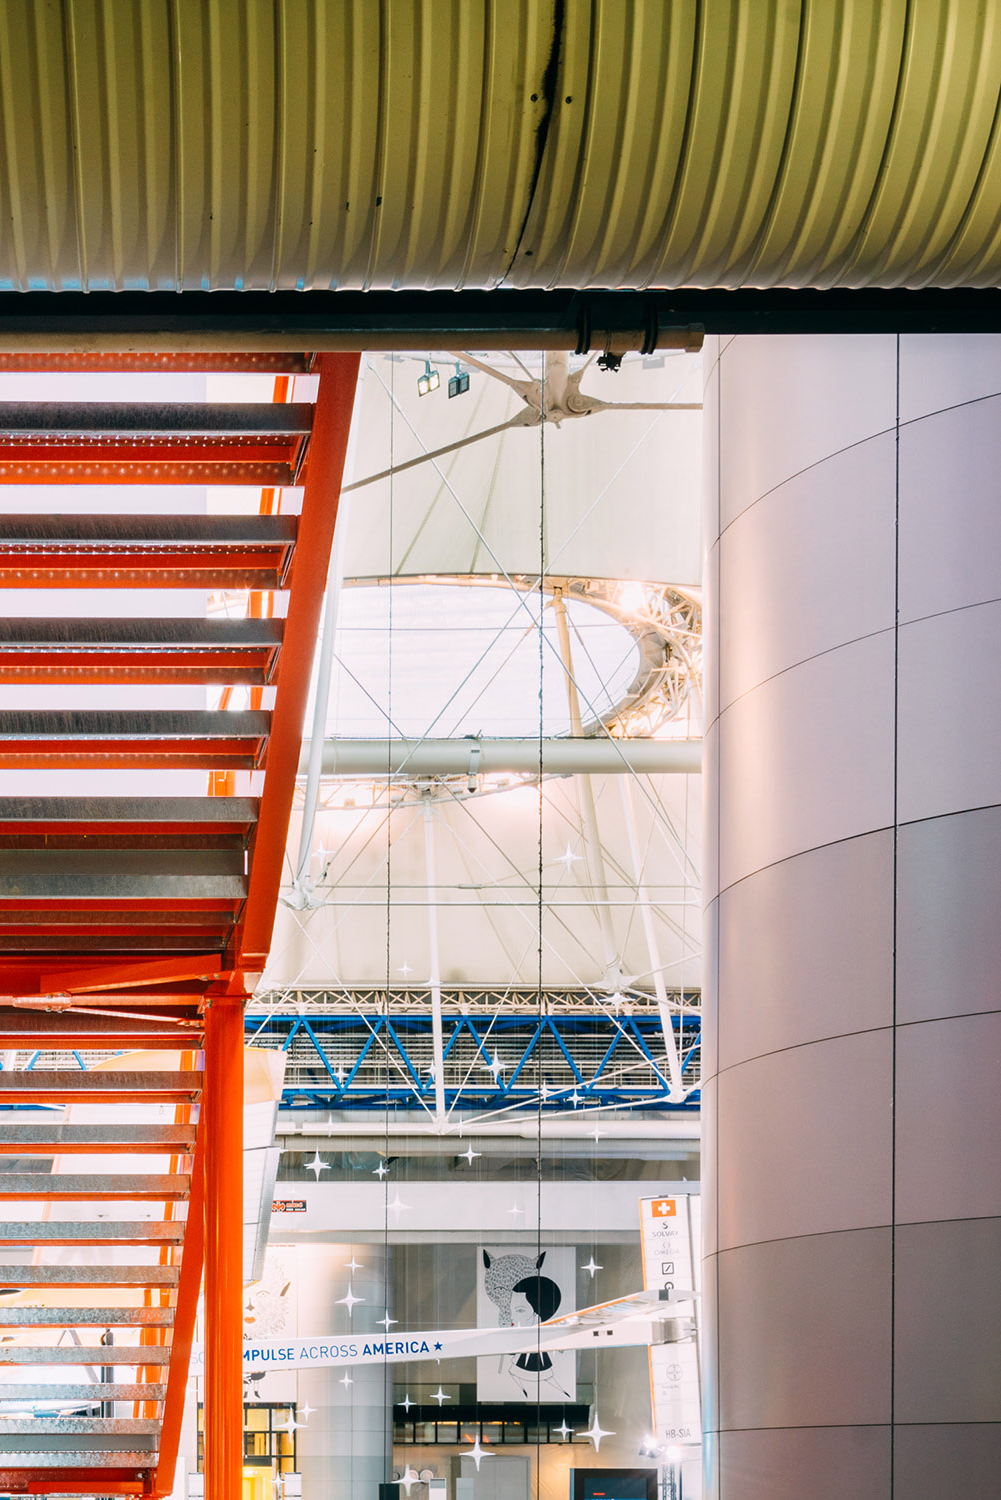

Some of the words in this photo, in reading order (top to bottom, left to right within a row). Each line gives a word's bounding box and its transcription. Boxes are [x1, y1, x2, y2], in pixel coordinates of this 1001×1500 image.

[651, 1230, 679, 1238] SOLVAY
[242, 1348, 295, 1362] MPULSE
[299, 1344, 358, 1360] ACROSS
[362, 1341, 430, 1357] AMERICA
[665, 1428, 692, 1439] HB-SIA
